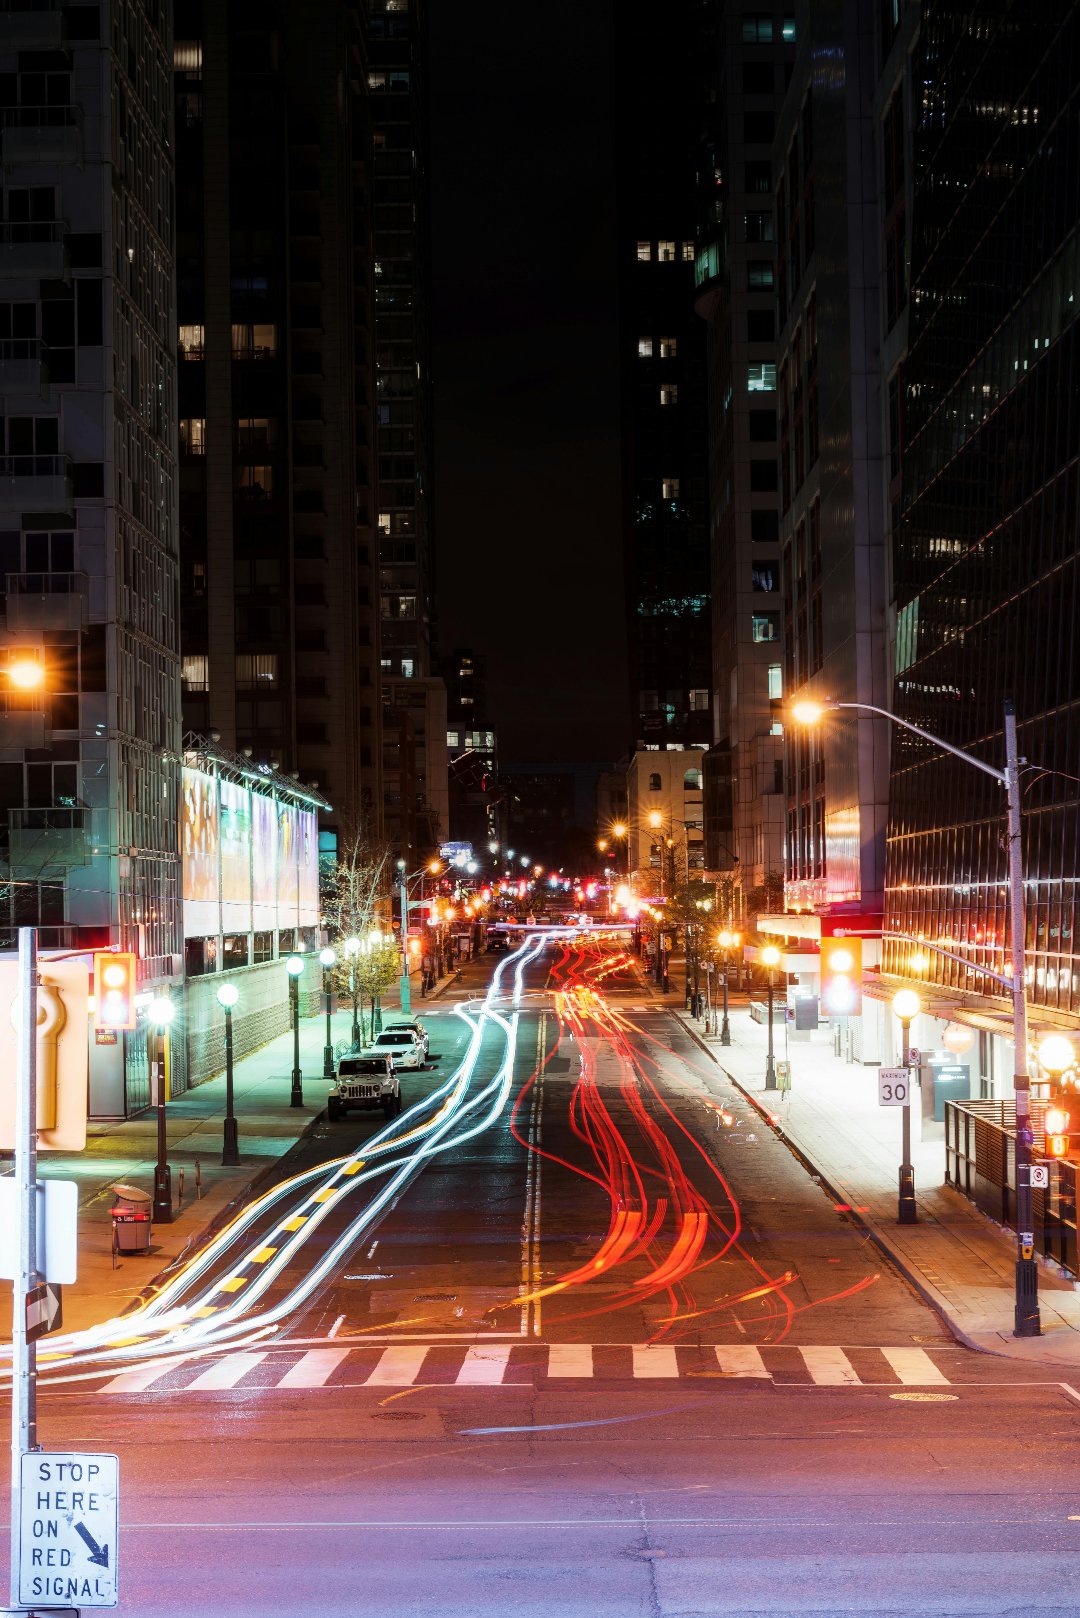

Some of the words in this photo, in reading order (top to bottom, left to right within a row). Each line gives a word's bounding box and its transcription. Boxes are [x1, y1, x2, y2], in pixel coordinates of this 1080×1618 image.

[882, 1084, 906, 1101] 30
[39, 1462, 100, 1482] STOP
[37, 1491, 99, 1511] HERE
[33, 1519, 58, 1538] ON
[32, 1548, 71, 1567] RED
[32, 1577, 105, 1597] SIGNAL
